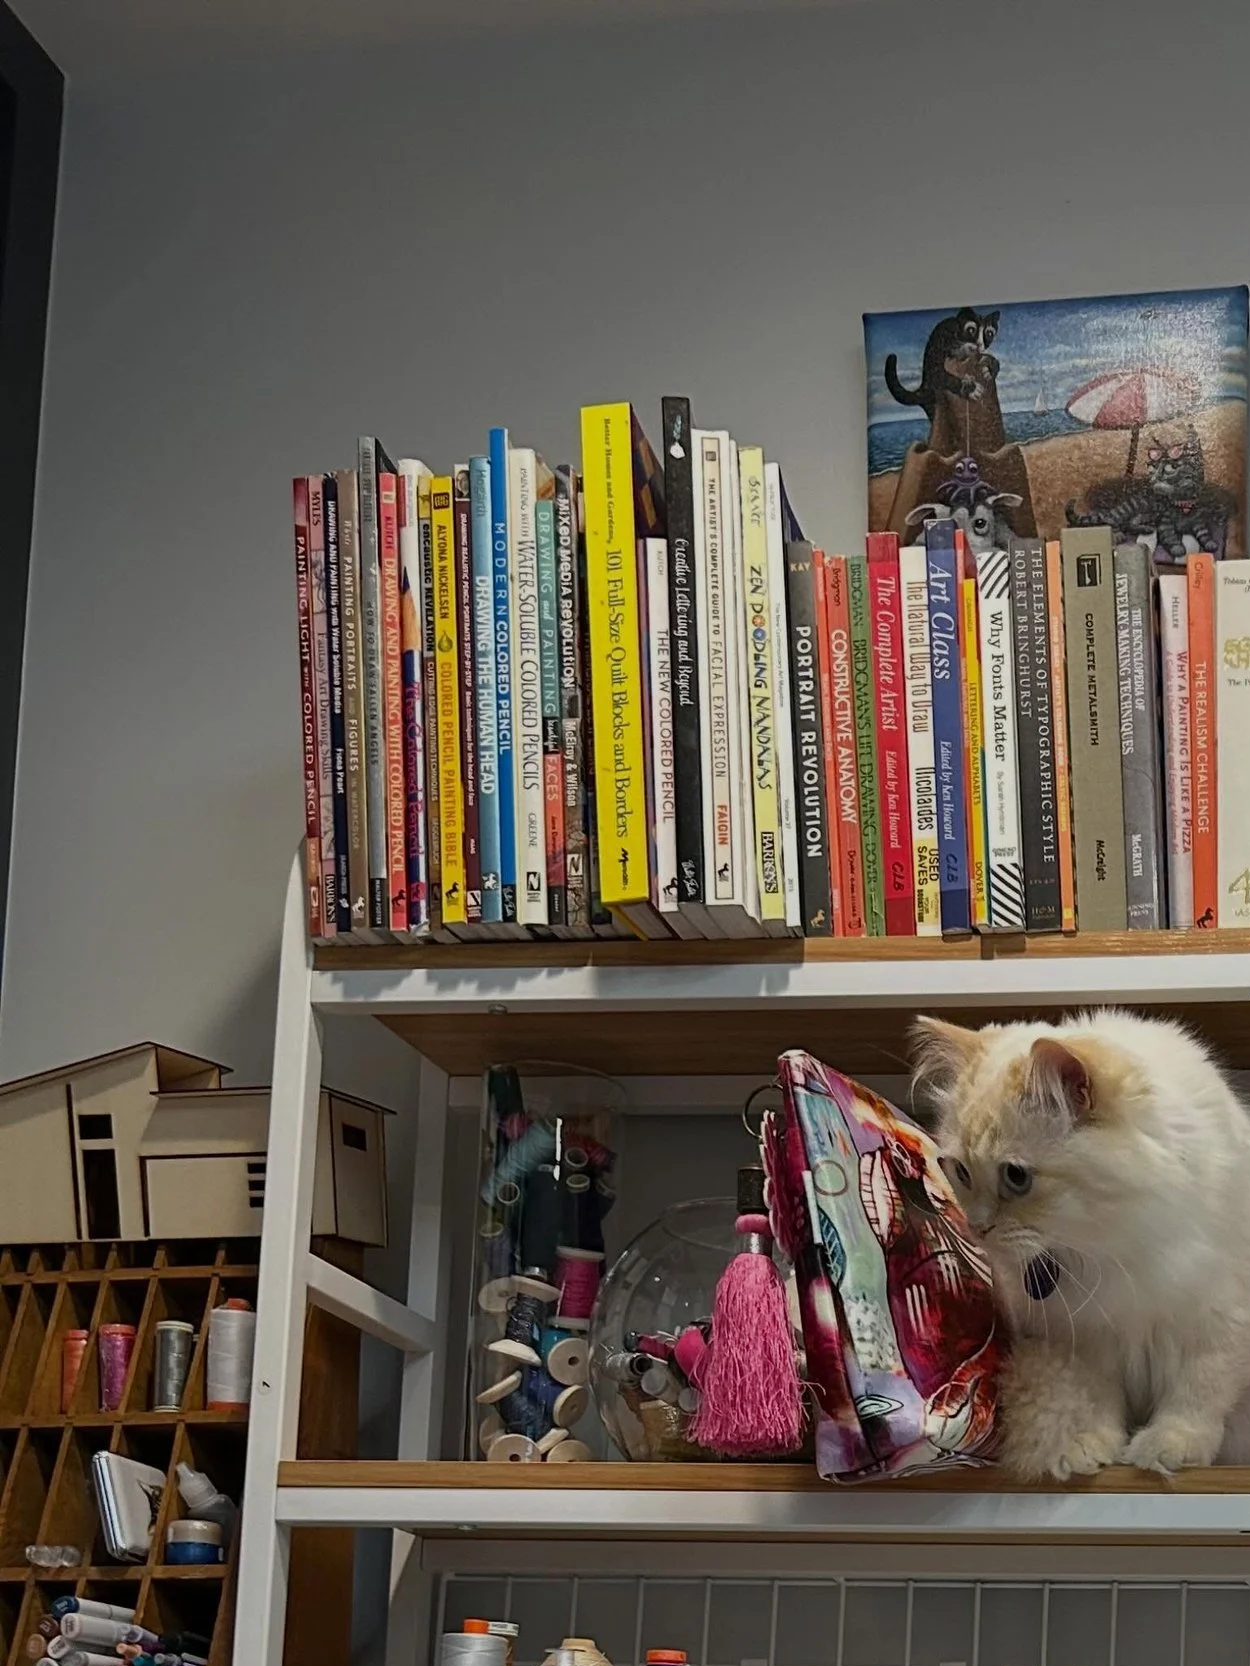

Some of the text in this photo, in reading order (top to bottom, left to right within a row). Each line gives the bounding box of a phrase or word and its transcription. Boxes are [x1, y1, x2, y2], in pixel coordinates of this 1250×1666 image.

[344, 556, 355, 618] PAINTING
[423, 524, 435, 652] encaustic REVELATION
[437, 524, 450, 620] ALYONA NICKELSEN
[789, 562, 811, 573] KAY
[850, 564, 864, 627] BRIDGMAN
[929, 561, 955, 680] Art Class
[297, 536, 316, 823] PAINTING LIGHT COLORED PENCIL
[346, 622, 357, 691] PORTRAITS
[476, 575, 495, 794] DRAWING THE HUMAN HEAD
[494, 522, 511, 755] MODERN COLORED PENCIL
[538, 511, 559, 801] DRAWING PAINTING FACES
[674, 587, 693, 706] Lettering and Beyond
[710, 543, 727, 779] COMPLETE FACIAL EXPRESSION
[874, 577, 899, 730] The Complete Artist
[987, 611, 1007, 762] Why Fonts Matter
[1014, 549, 1032, 719] ROBERT BRINGHURST
[1085, 613, 1100, 746] COMPLETE METALSMITH
[319, 699, 331, 746] Drawing
[321, 749, 333, 780] Skills
[349, 719, 359, 772] FIGURES
[385, 558, 405, 875] DRAWING AND PAINTING WITH COLORED PENCIL
[440, 662, 457, 868] COLORED PENCIL PAINTING BIBLE
[520, 660, 540, 790] COLORED PENCILS
[608, 578, 634, 837] Full-Size Quilt Blocks and Borders
[657, 629, 675, 823] THE NEW COLORED PENCIL
[796, 626, 822, 858] PORTRAIT REVOLUTION
[831, 629, 858, 824] CONSTRUCTIVE ANATOMY
[911, 700, 931, 733] Draw
[1031, 547, 1055, 864] THE ELEMENTS OF TYPOGRAPHIC STYLE
[1119, 679, 1134, 756] TECHNIQUES
[1195, 661, 1209, 834] THE REALISM CHALLENGE
[528, 813, 538, 848] GREENE
[567, 774, 578, 806] Wilson
[716, 804, 729, 846] FAIGIN
[918, 845, 932, 886] SAVES
[929, 846, 940, 882] USED
